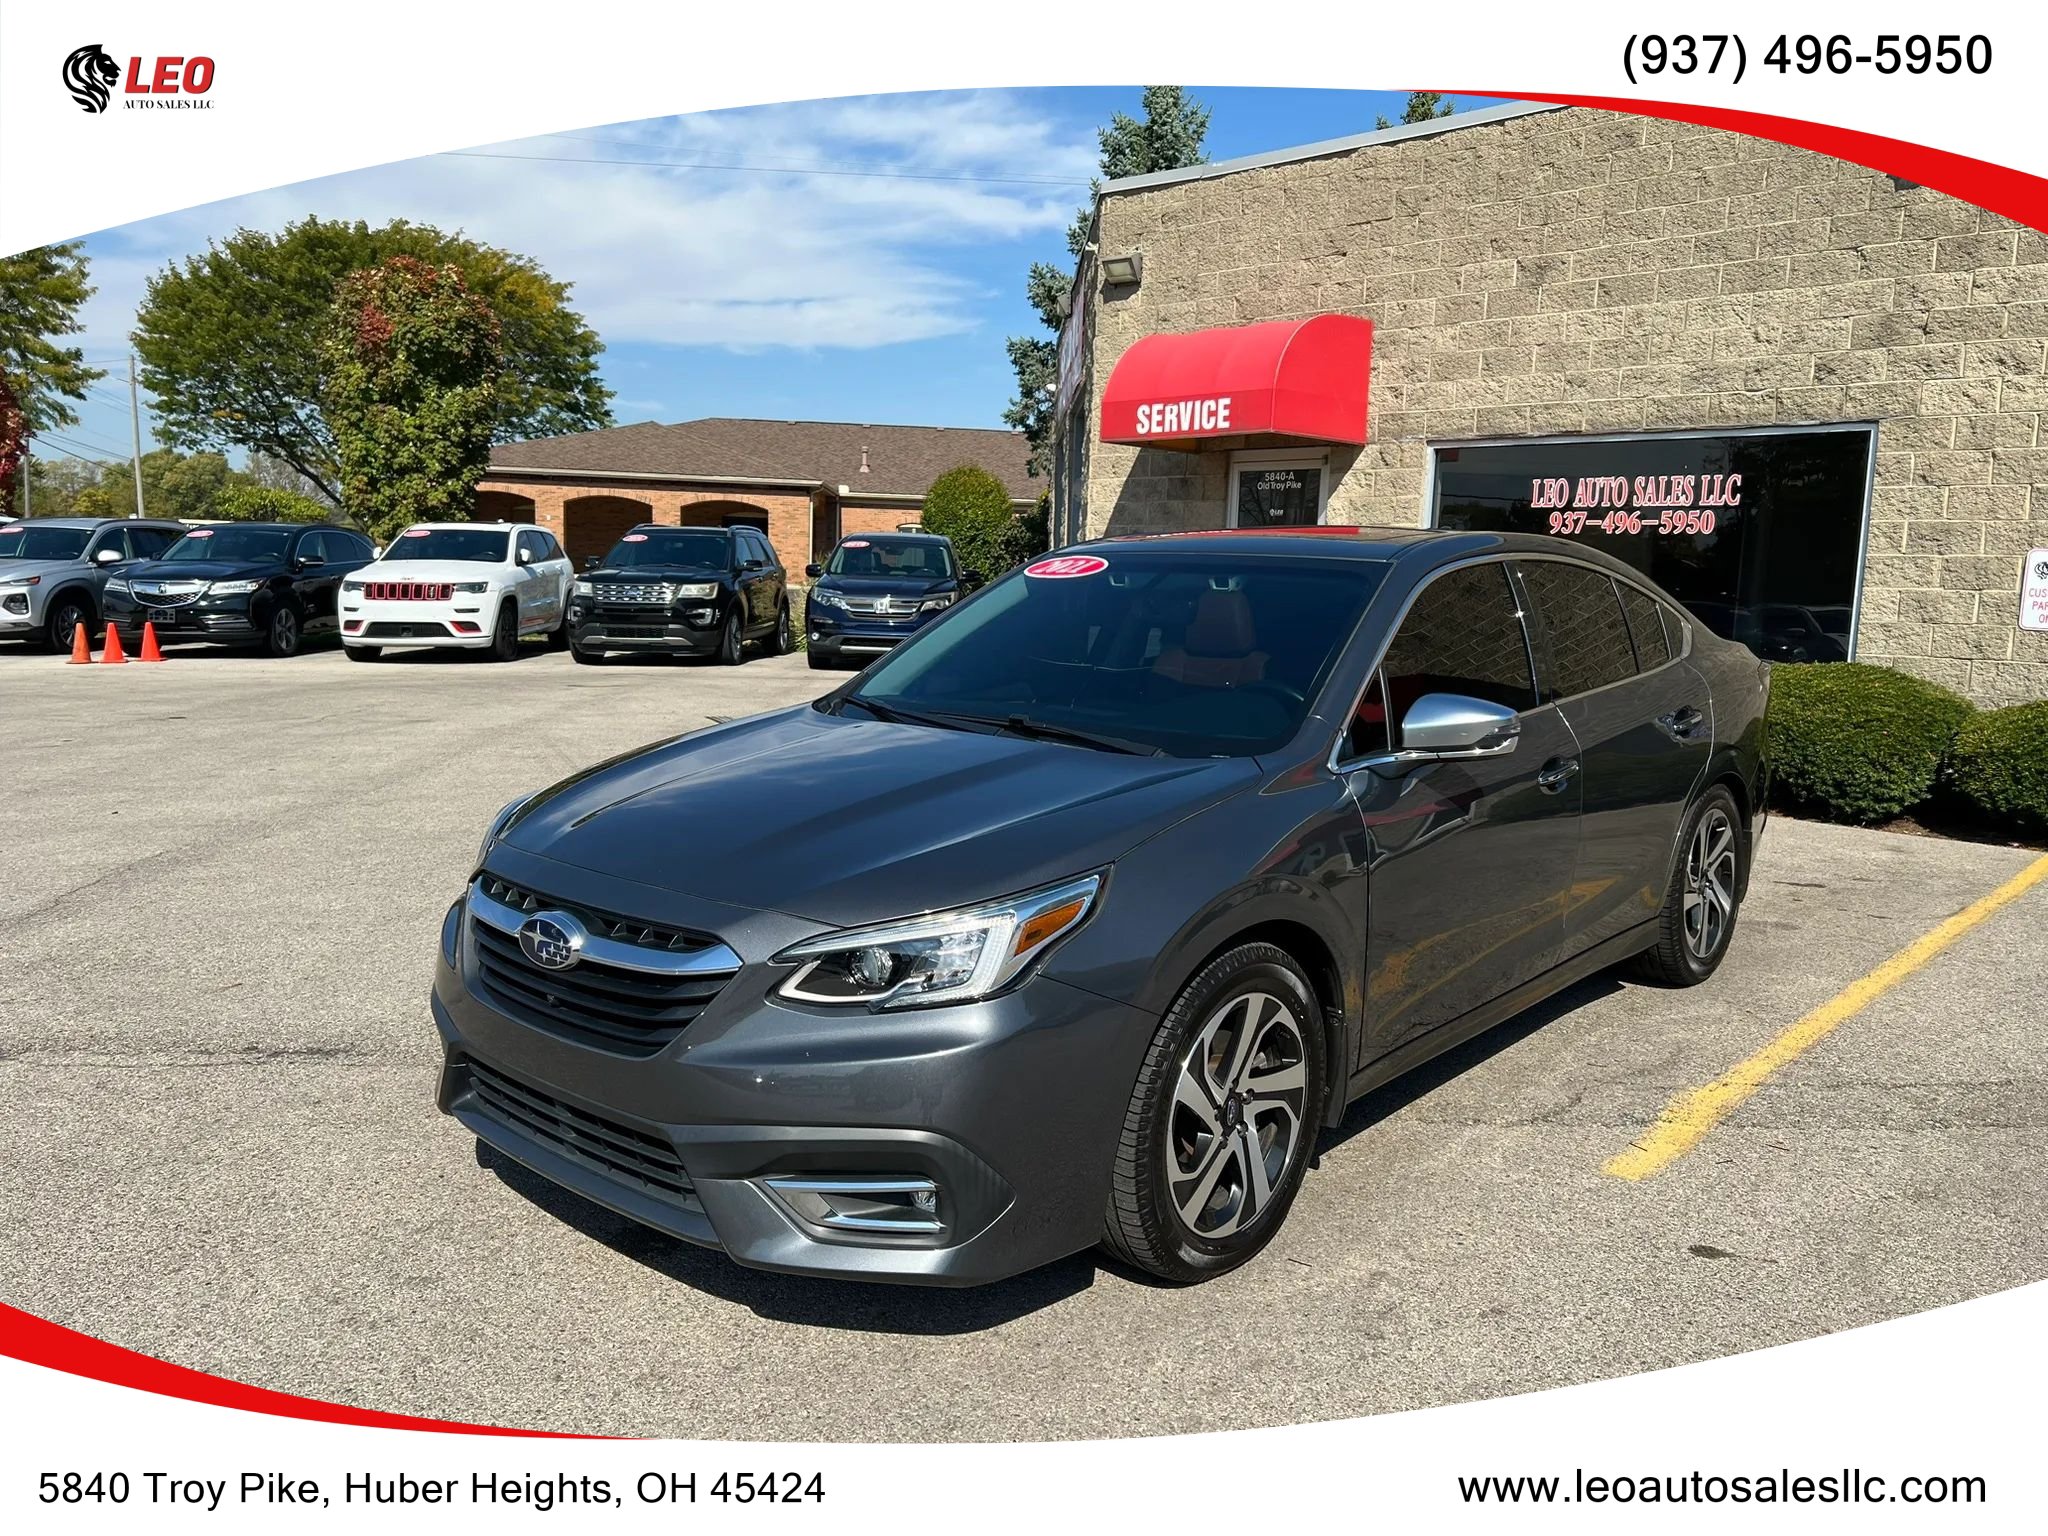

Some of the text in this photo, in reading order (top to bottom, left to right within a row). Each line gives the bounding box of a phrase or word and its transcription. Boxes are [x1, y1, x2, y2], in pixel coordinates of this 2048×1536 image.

[1136, 397, 1231, 434] SERVICE
[1257, 480, 1302, 491] Old Troy Pike
[1264, 471, 1295, 481] 5840-A
[1531, 473, 1742, 508] LEO AUTO SALES LLC
[1549, 509, 1716, 535] 937-496-5950
